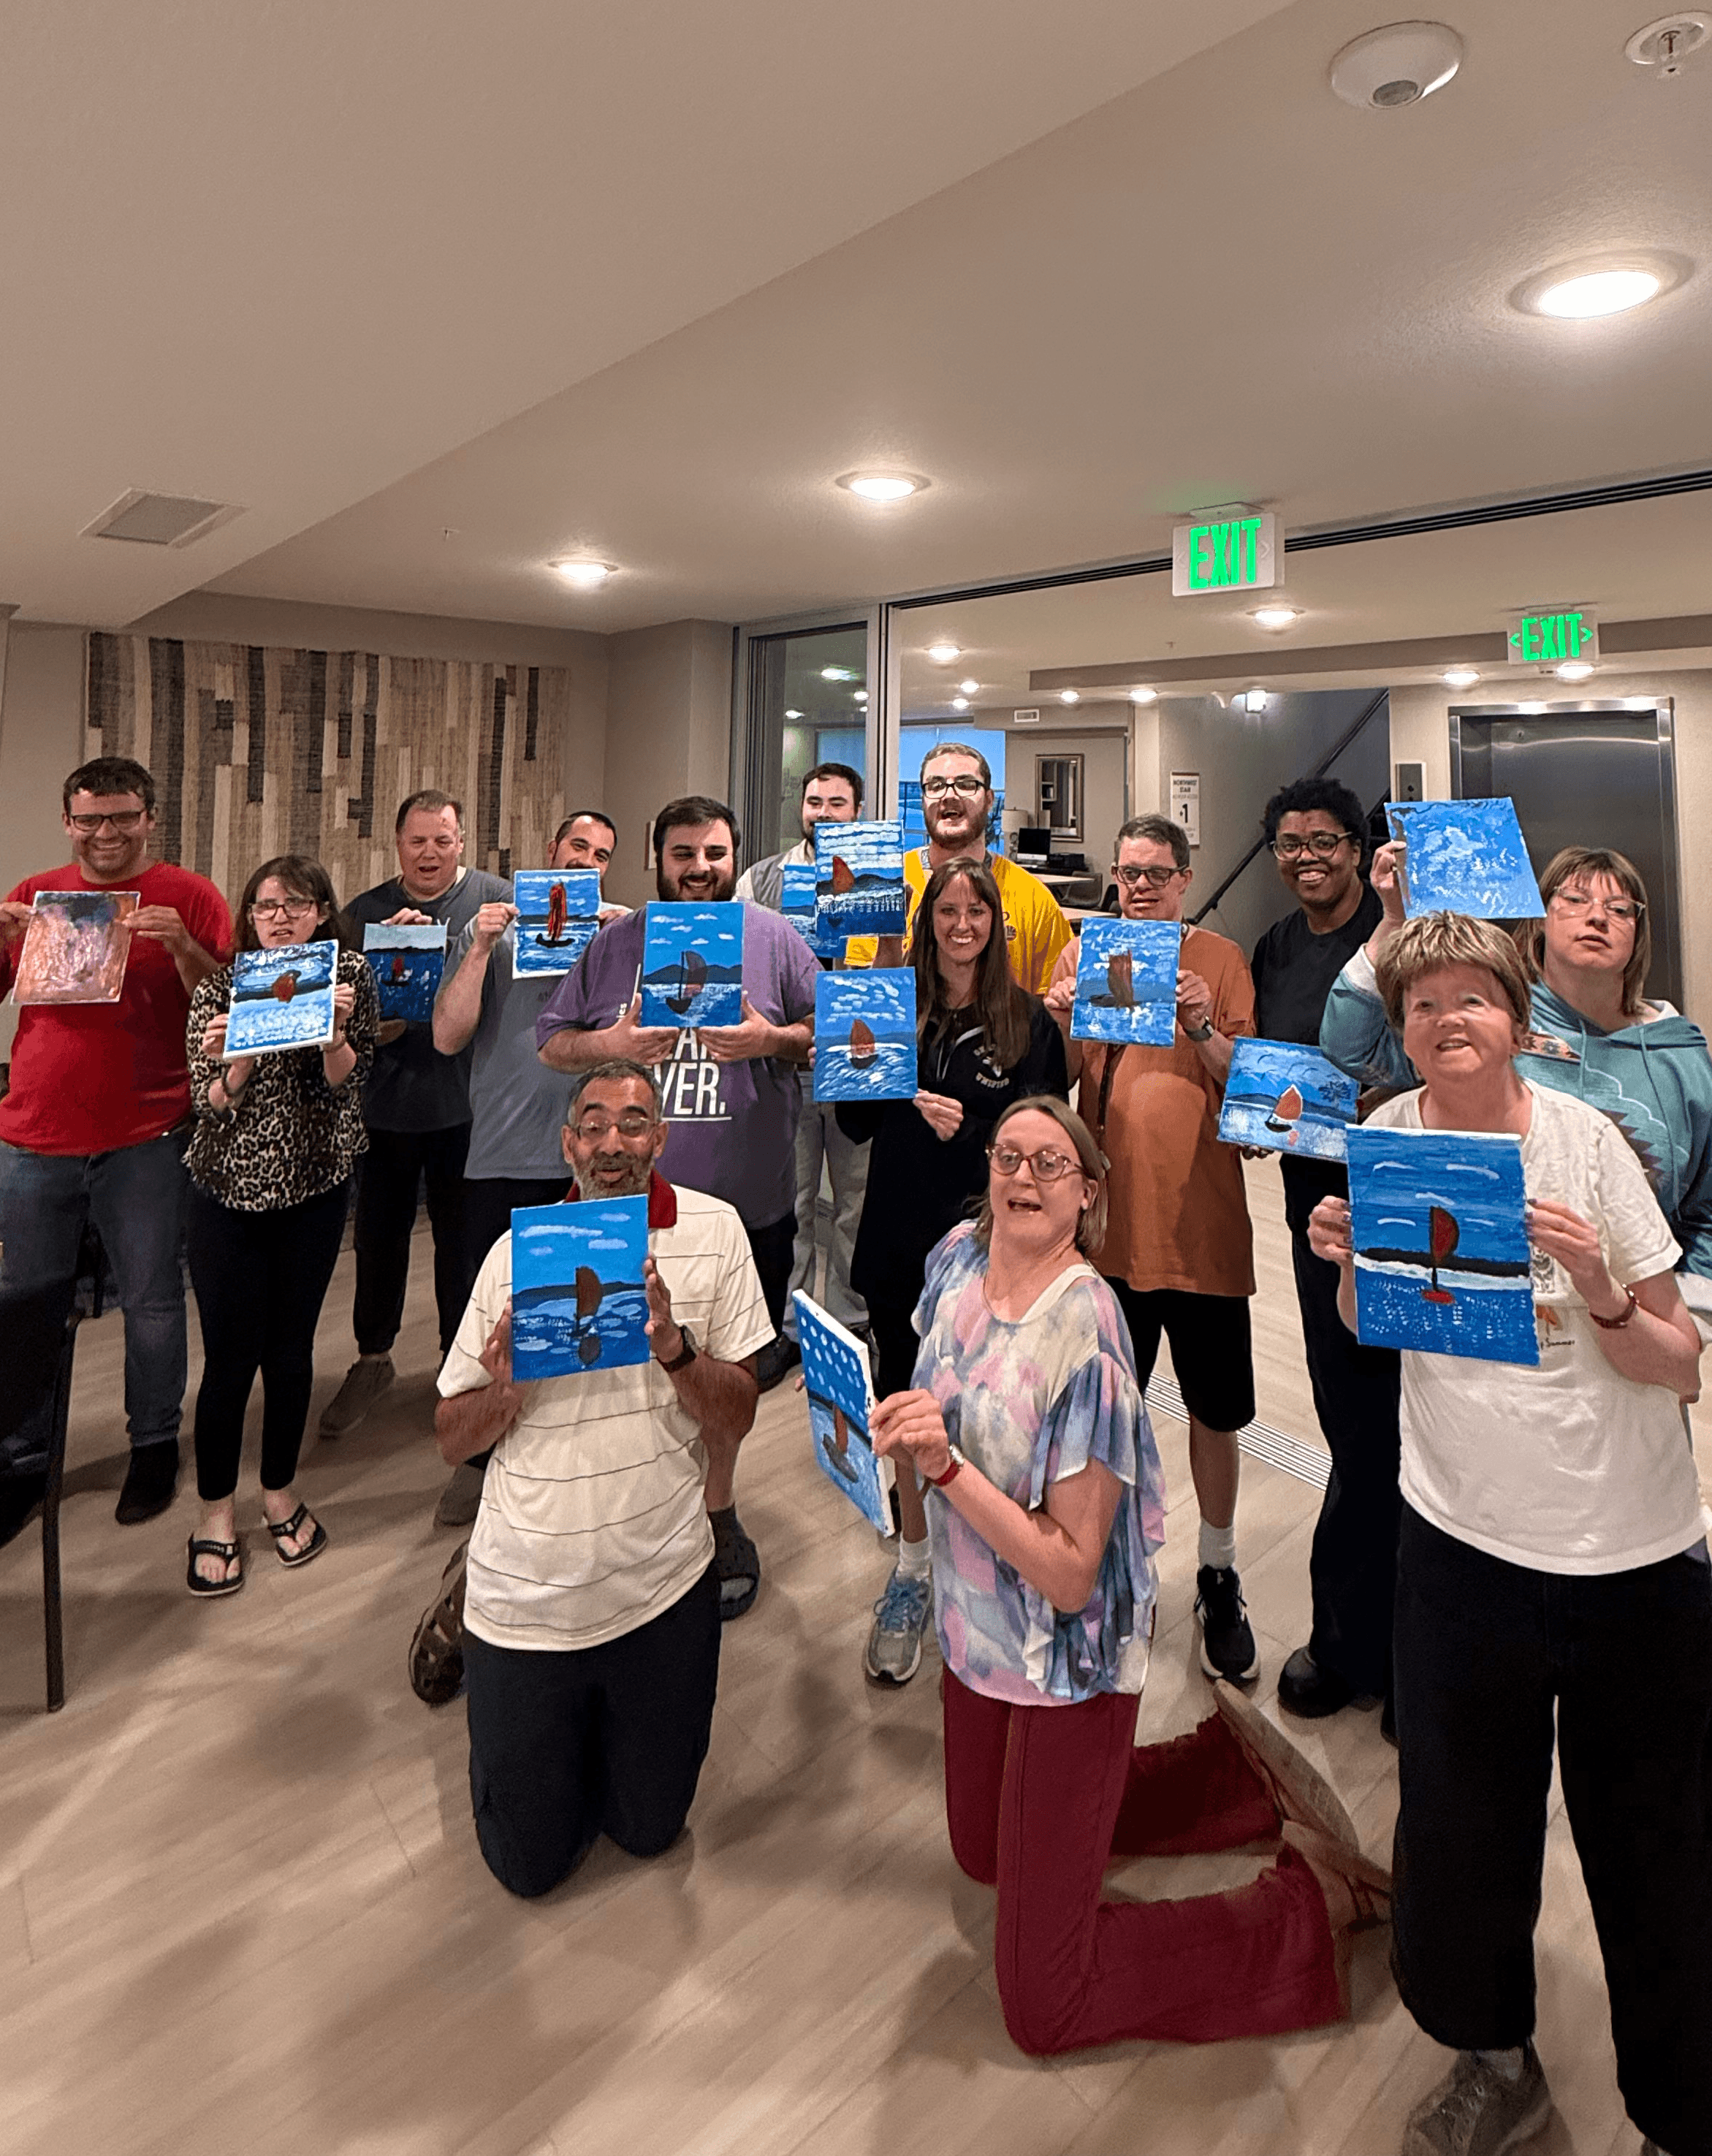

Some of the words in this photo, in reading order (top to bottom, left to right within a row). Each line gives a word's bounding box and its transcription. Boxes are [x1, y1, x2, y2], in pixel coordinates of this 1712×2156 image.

[1190, 518, 1262, 590] EXIT
[1522, 613, 1583, 661] EXIT
[653, 1062, 726, 1115] VER.
